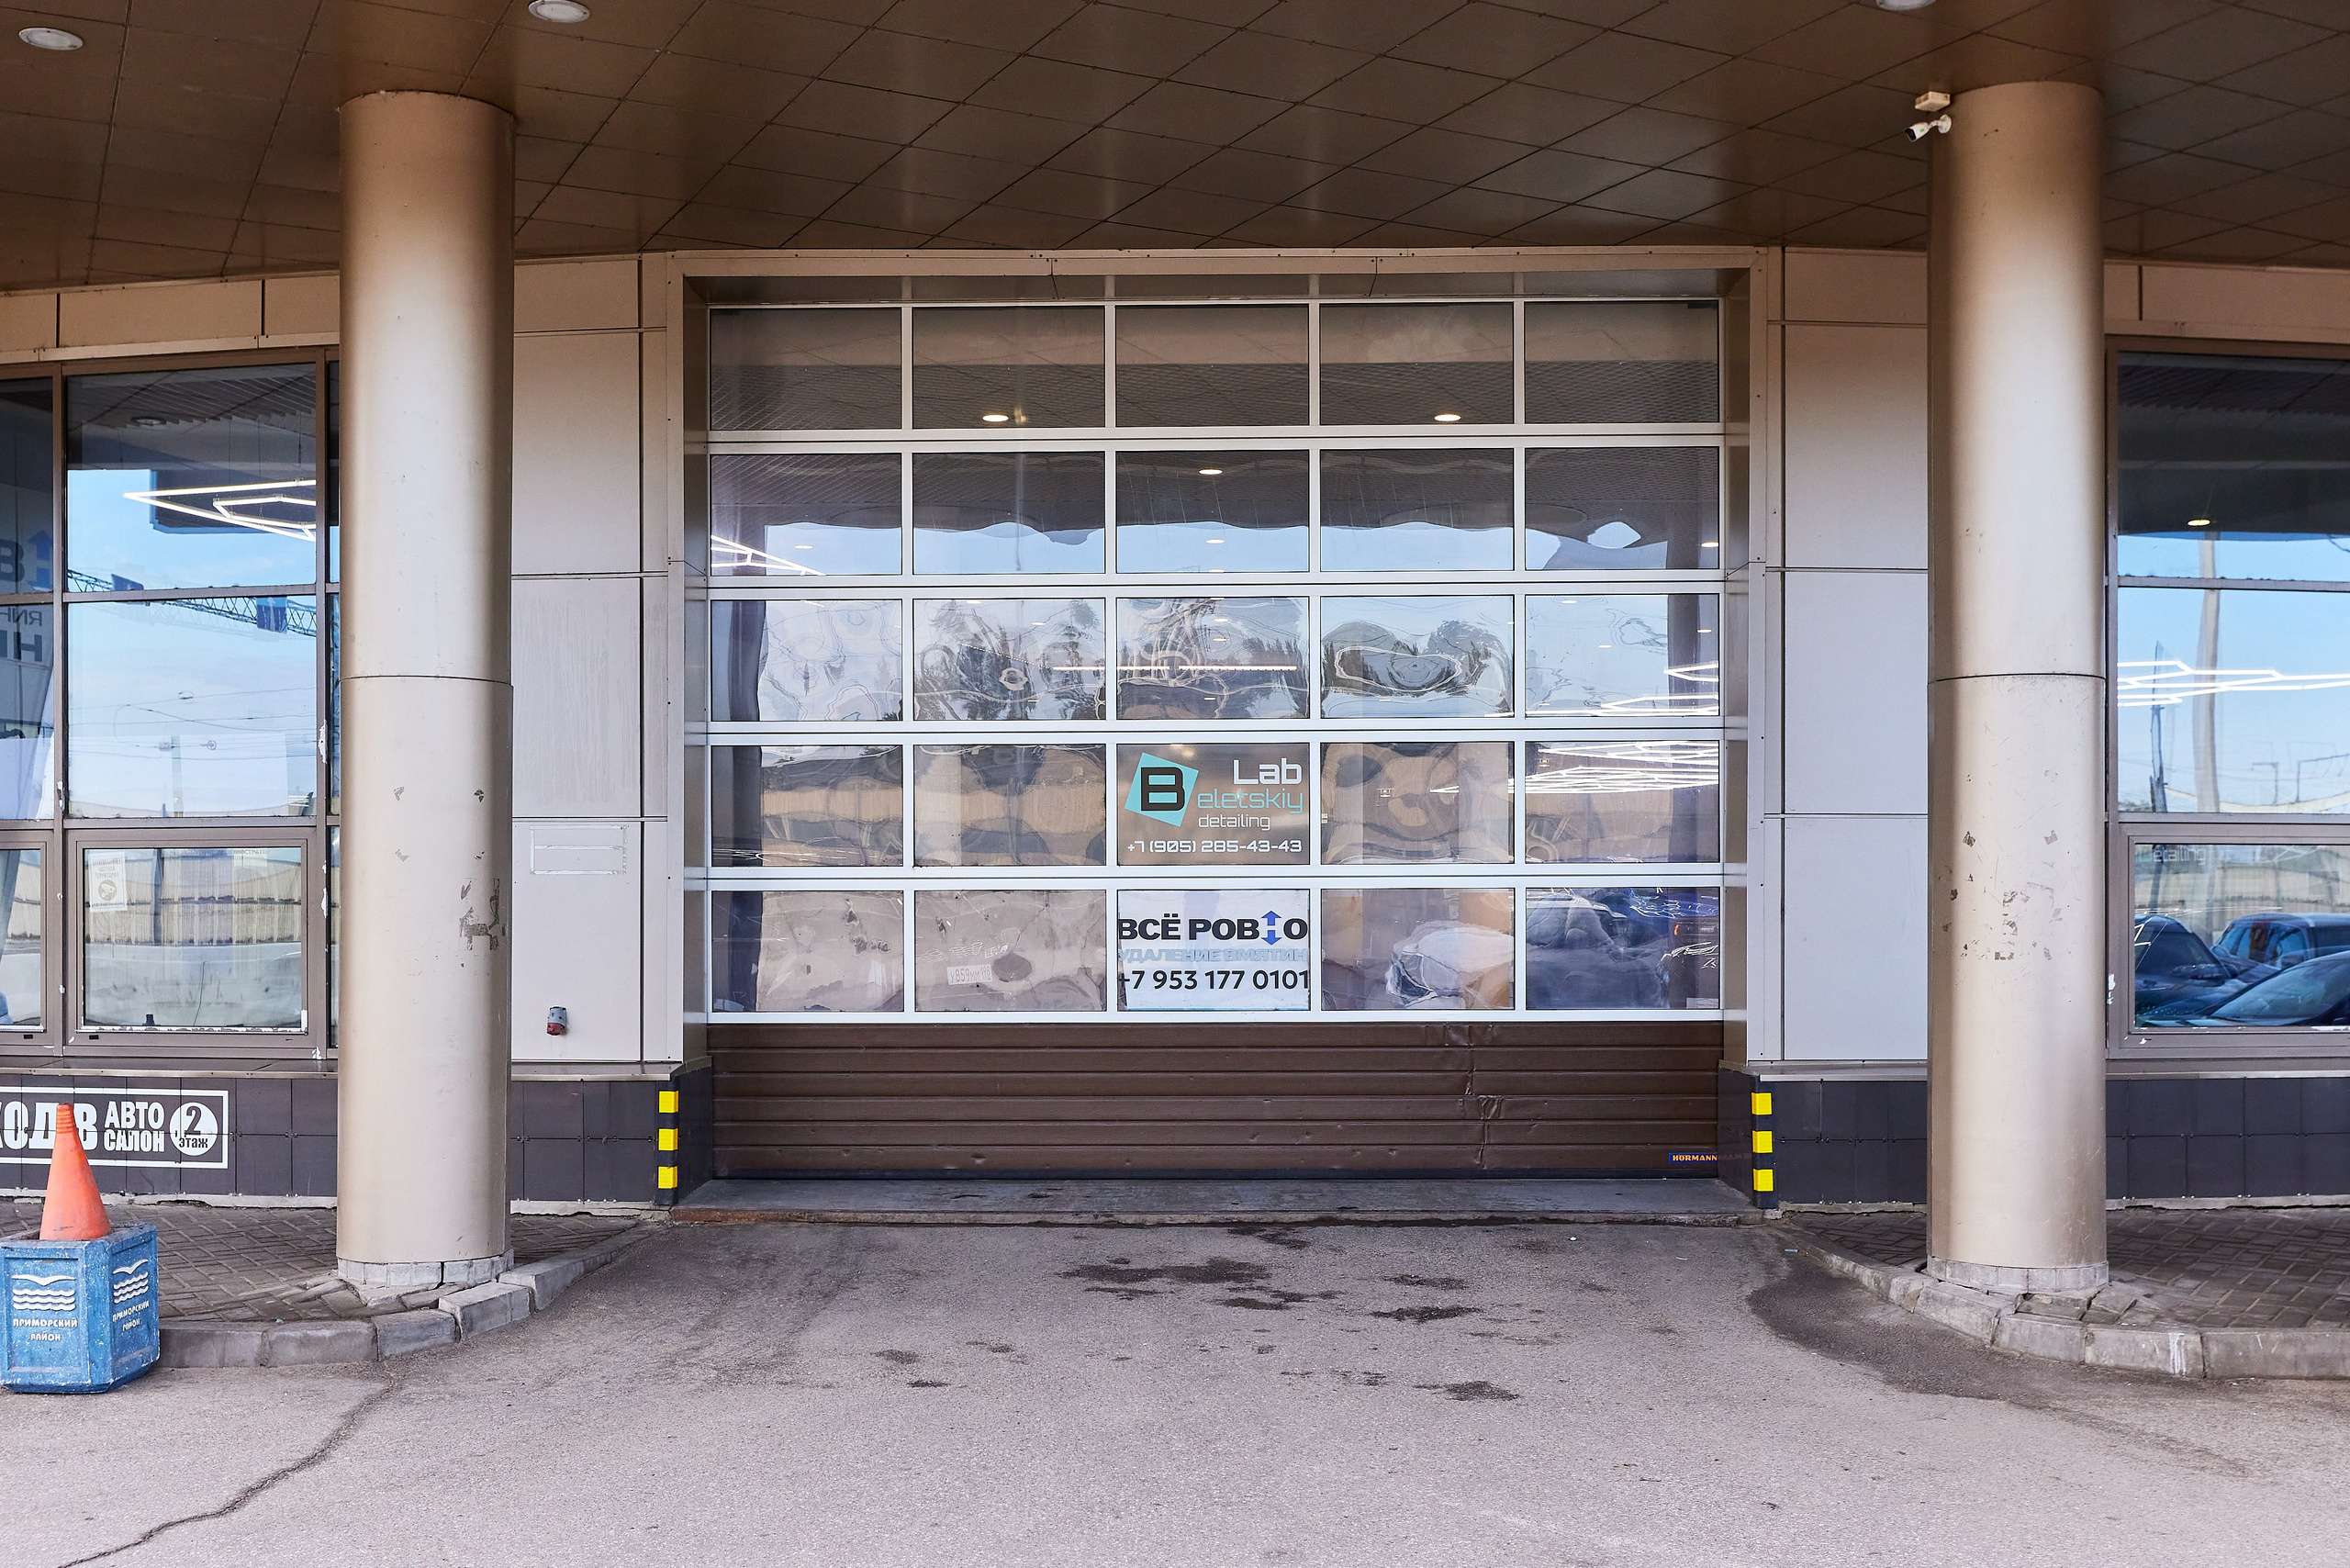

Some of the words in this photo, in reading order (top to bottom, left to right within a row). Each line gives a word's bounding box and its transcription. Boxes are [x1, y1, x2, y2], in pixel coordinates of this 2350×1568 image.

[1233, 757, 1303, 785] Lab
[1198, 814, 1270, 831] detailing
[1127, 840, 1145, 853] +7
[1149, 840, 1196, 853] (905)
[1201, 840, 1303, 853] 285-43-43
[1118, 913, 1181, 940] ВСЁ
[1119, 948, 1222, 963] УДАЛЕНИЕ
[1223, 948, 1307, 962] ВМЯТИН
[1152, 970, 1198, 990] 953
[1204, 970, 1245, 990] 177
[1253, 970, 1308, 990] 0101
[0, 1101, 60, 1149] ОД
[104, 1101, 165, 1129] АВТО
[185, 1105, 202, 1136] 2
[104, 1130, 165, 1152] САЛОН
[179, 1137, 208, 1148] этаж
[13, 1316, 78, 1327] ПРИМОРСКИЙ
